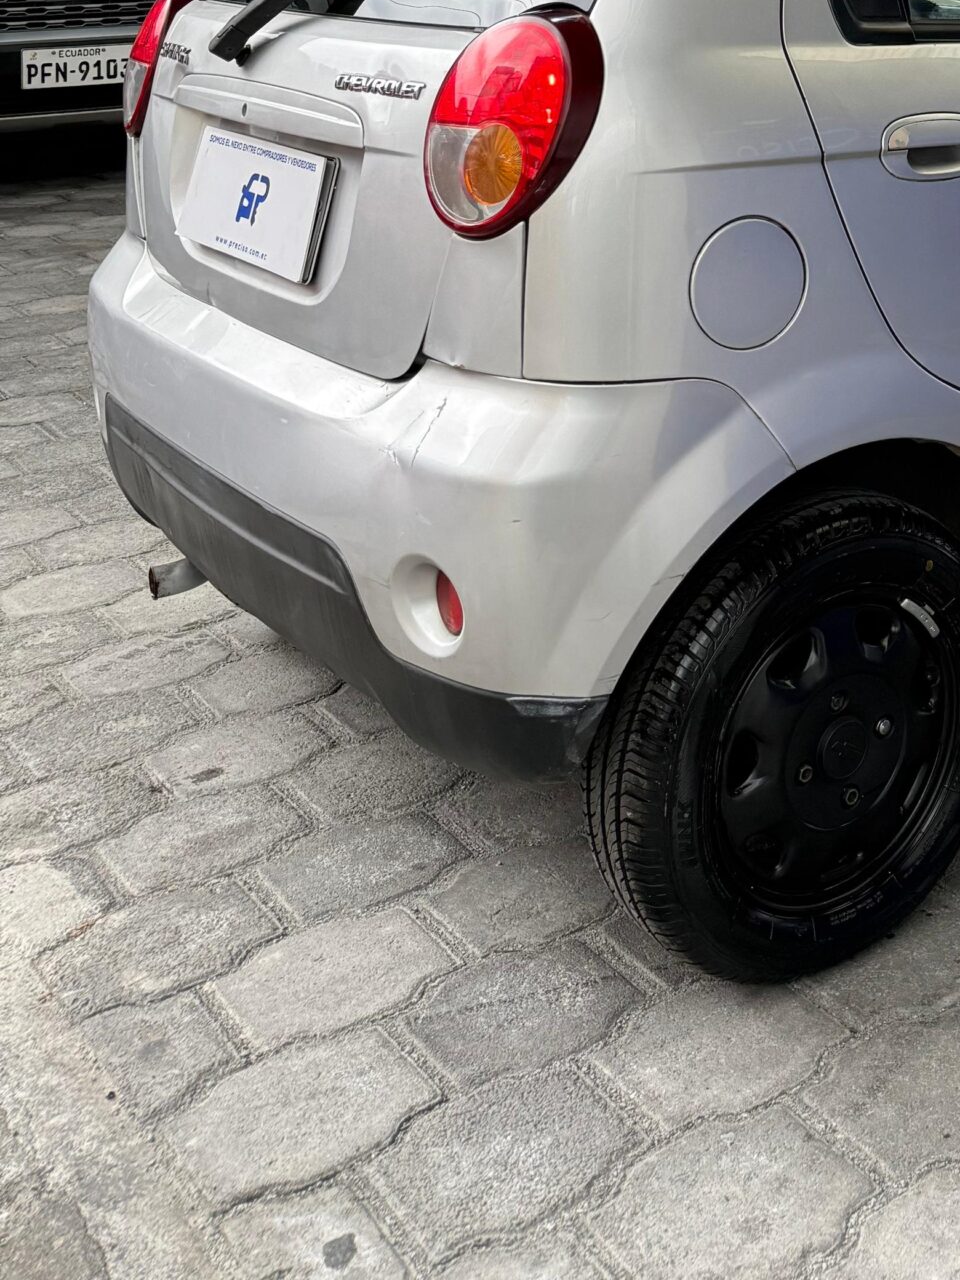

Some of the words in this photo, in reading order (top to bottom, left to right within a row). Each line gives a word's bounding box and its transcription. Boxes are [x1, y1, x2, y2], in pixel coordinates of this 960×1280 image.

[58, 48, 101, 59] ECUADOR
[209, 134, 226, 147] SOMOS
[231, 140, 243, 151] NEXO
[242, 143, 257, 155] ENTRE
[256, 147, 288, 164] COMPRADORES
[290, 157, 318, 173] VENDEDORES
[215, 235, 268, 261] www.preciso.com.ec
